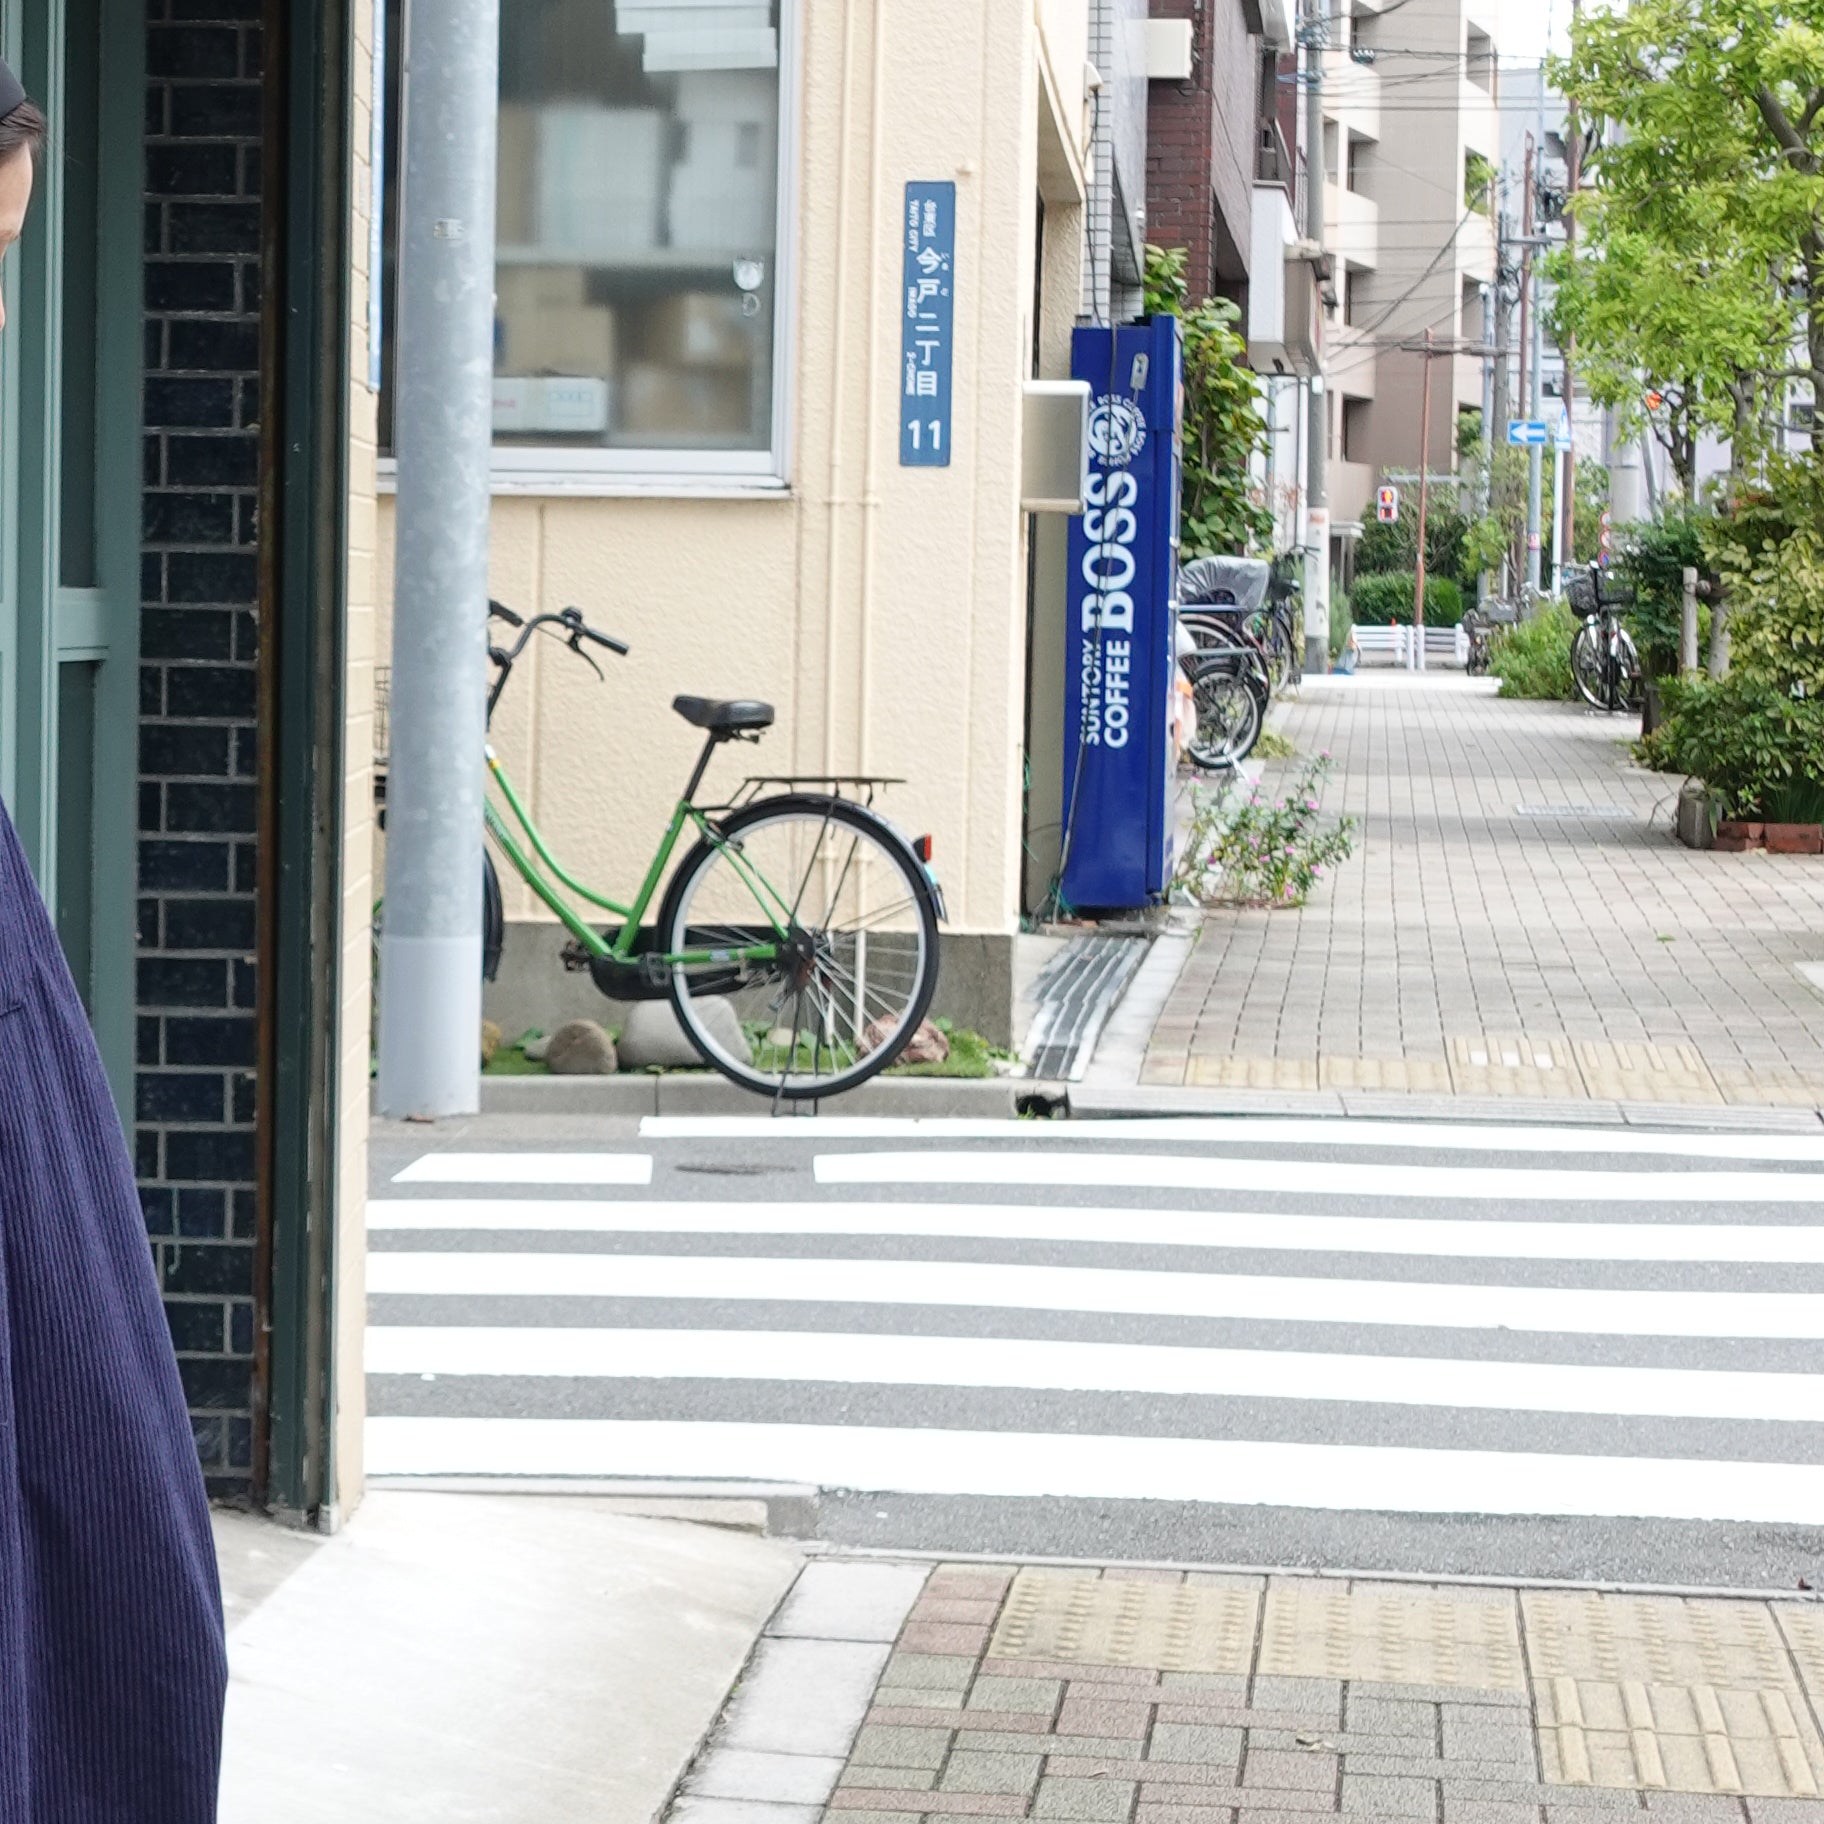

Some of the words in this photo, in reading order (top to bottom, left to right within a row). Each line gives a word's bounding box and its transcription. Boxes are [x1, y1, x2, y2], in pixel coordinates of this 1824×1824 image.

[915, 246, 942, 397] 今戸二丁目
[907, 419, 941, 450] 11
[1082, 470, 1138, 634] BOSS
[1104, 640, 1130, 748] COFFEE
